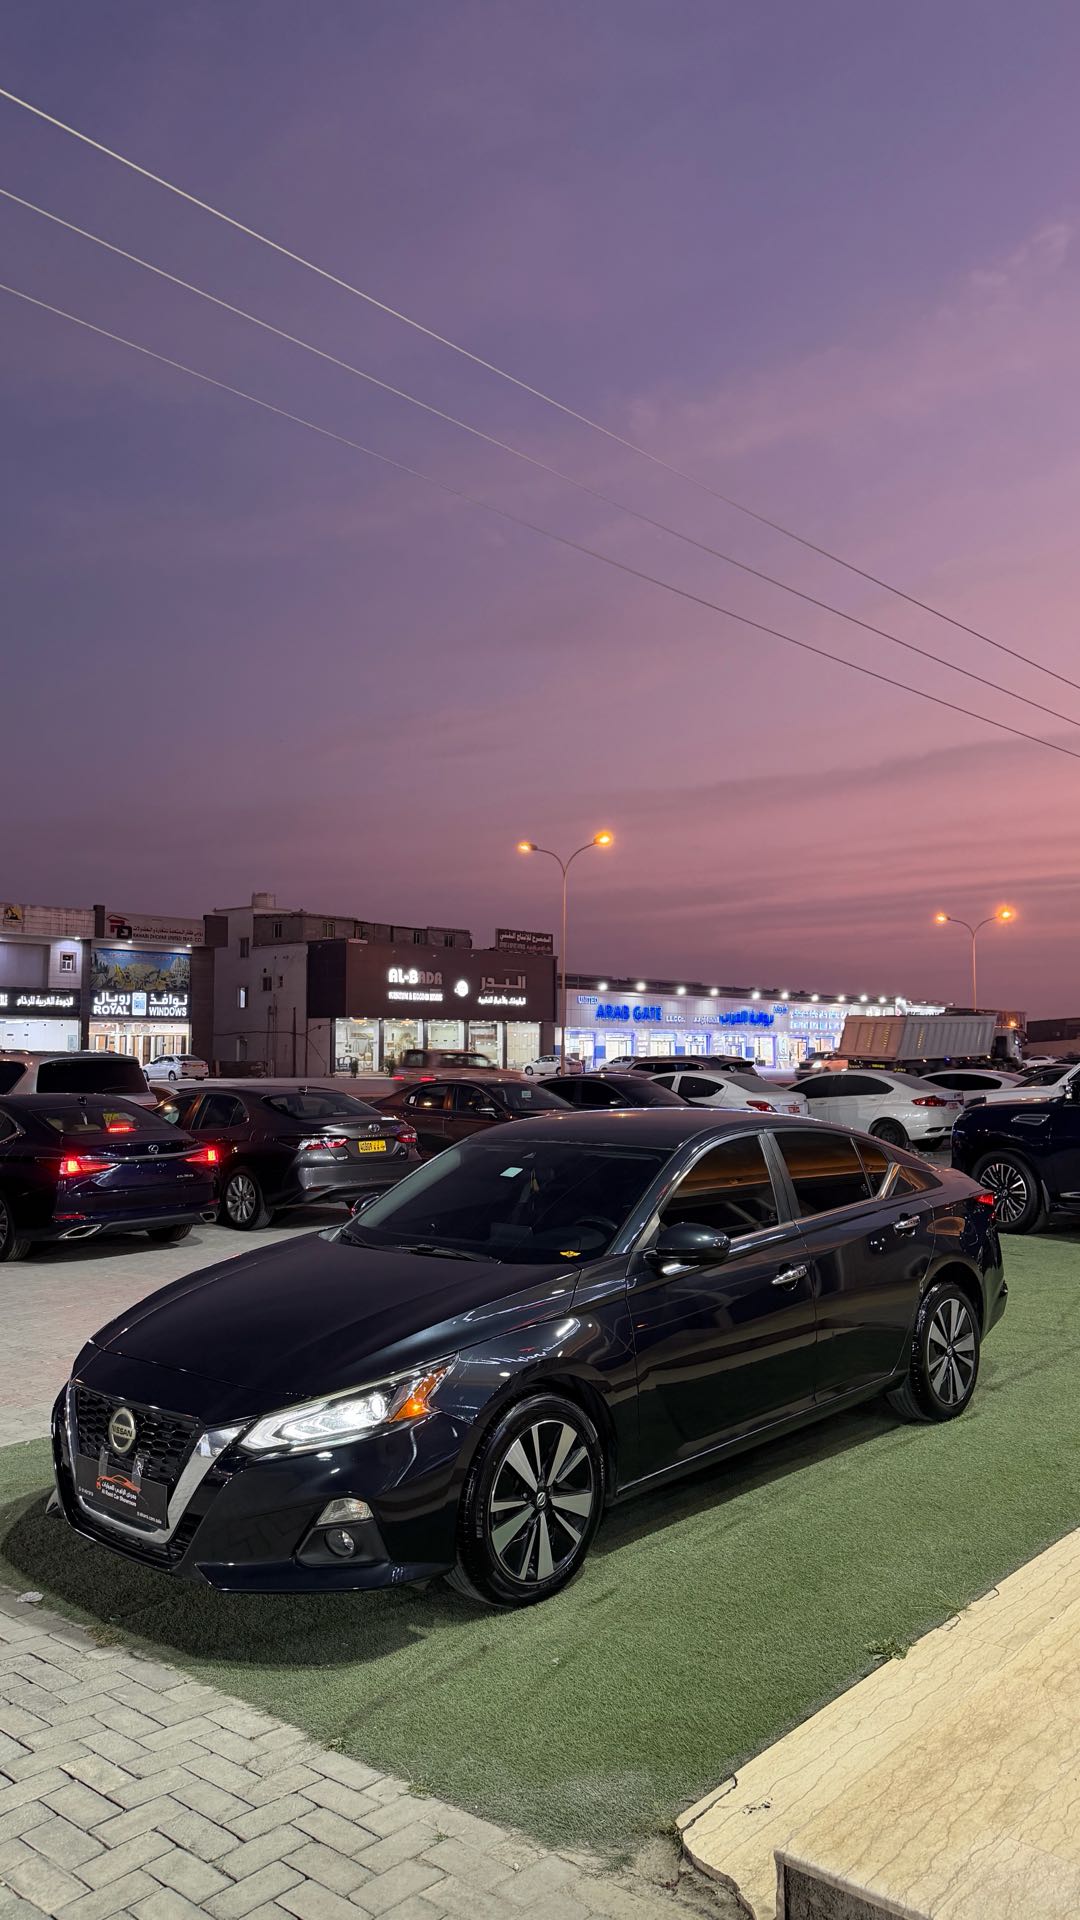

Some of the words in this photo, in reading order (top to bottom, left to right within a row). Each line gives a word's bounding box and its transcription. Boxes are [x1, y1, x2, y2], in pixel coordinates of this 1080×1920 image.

[480, 976, 526, 991] البدر
[94, 992, 130, 1007] رويال
[149, 993, 188, 1006] نوافذ
[578, 995, 598, 1004] UNITED
[93, 1004, 130, 1015] ROYAL
[148, 1006, 187, 1016] WINDOWS
[596, 1004, 630, 1020] ARAB
[633, 1005, 662, 1021] GATE
[112, 1424, 133, 1438] NISSAN
